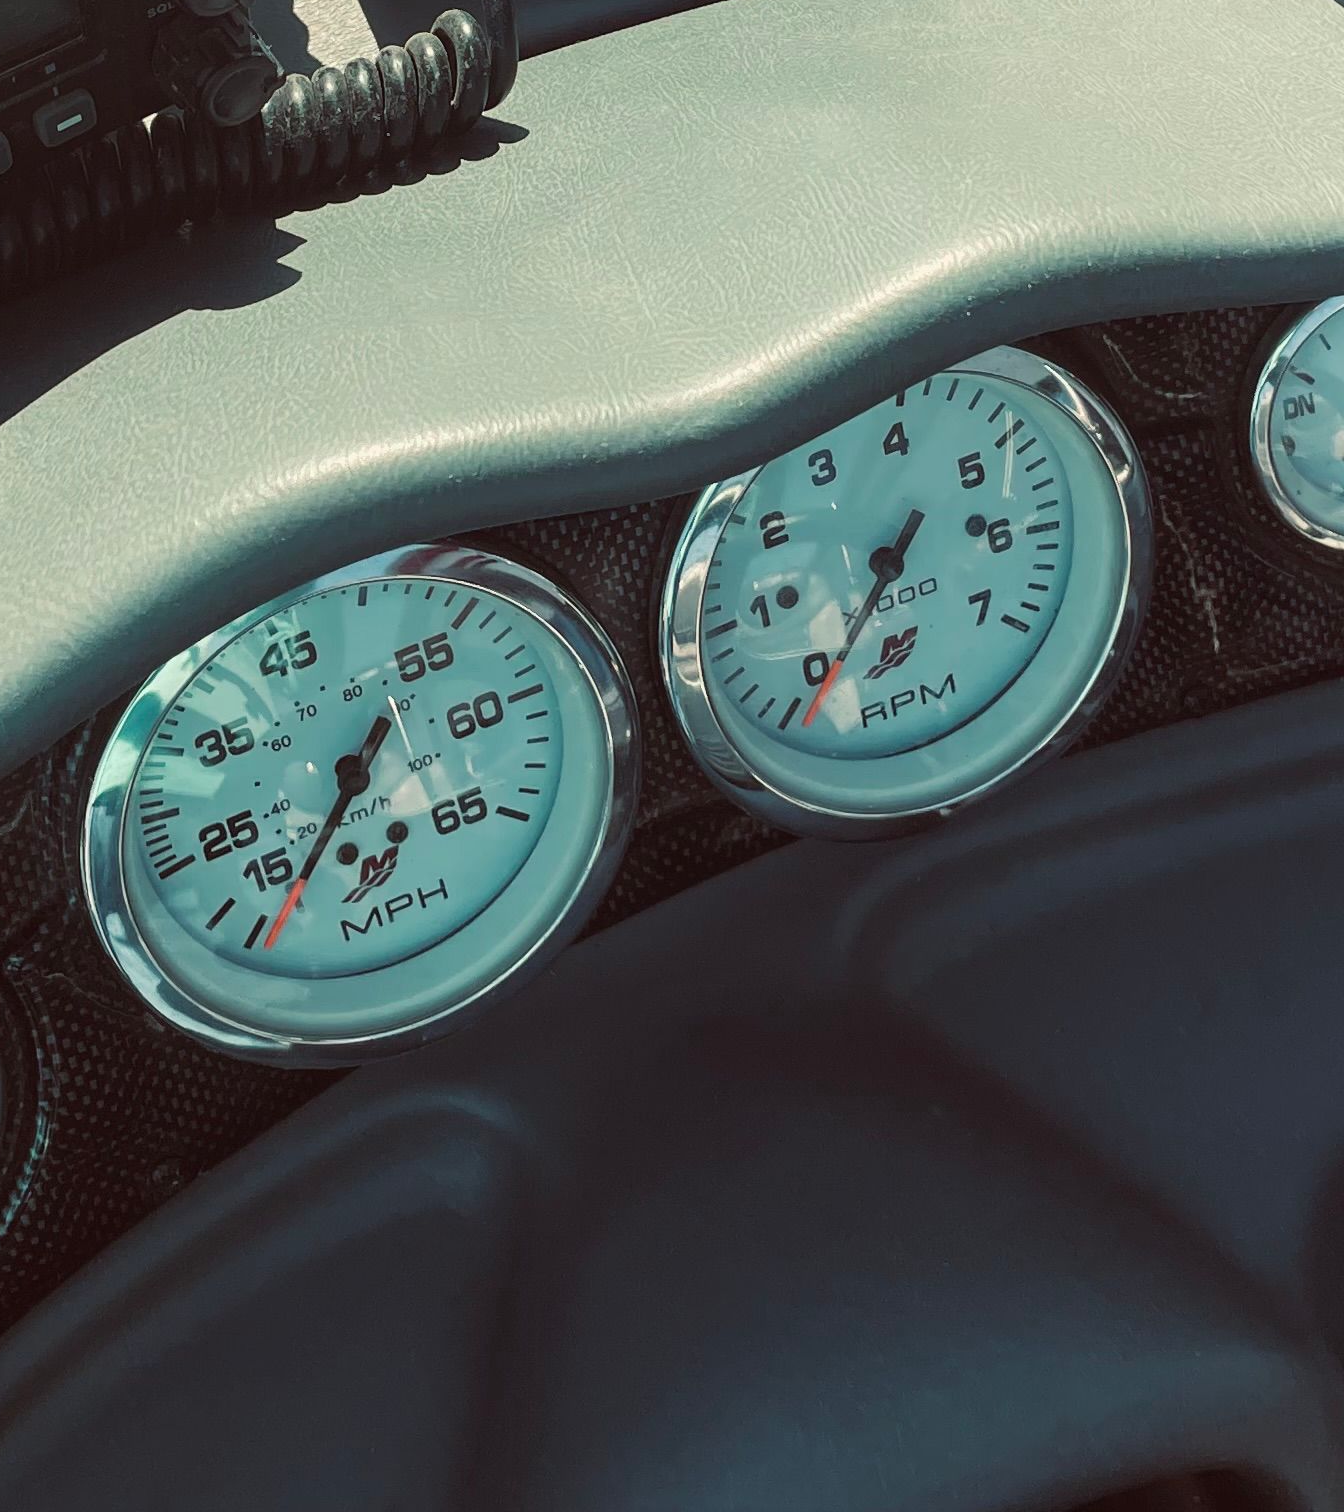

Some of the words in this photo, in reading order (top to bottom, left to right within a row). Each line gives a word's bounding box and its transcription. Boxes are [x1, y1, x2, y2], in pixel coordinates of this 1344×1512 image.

[1283, 391, 1316, 420] DN
[882, 421, 909, 456] 4
[808, 448, 837, 487] 3
[957, 451, 985, 489] 5
[759, 511, 789, 549] 2
[987, 518, 1013, 554] 6
[750, 594, 771, 627] 1
[968, 589, 992, 627] 7
[258, 630, 318, 677] 45
[394, 631, 454, 683] 55
[802, 651, 830, 687] 0
[342, 684, 364, 702] 80
[861, 673, 956, 728] RPM
[297, 704, 317, 722] 70
[446, 691, 504, 739] 60
[194, 716, 255, 768] 35
[270, 734, 292, 752] 60
[408, 754, 434, 773] 100
[270, 798, 291, 816] 40
[431, 786, 488, 835] 65
[198, 809, 259, 861] 25
[297, 822, 317, 839] 20
[243, 846, 294, 892] 15
[340, 878, 449, 942] MPH
